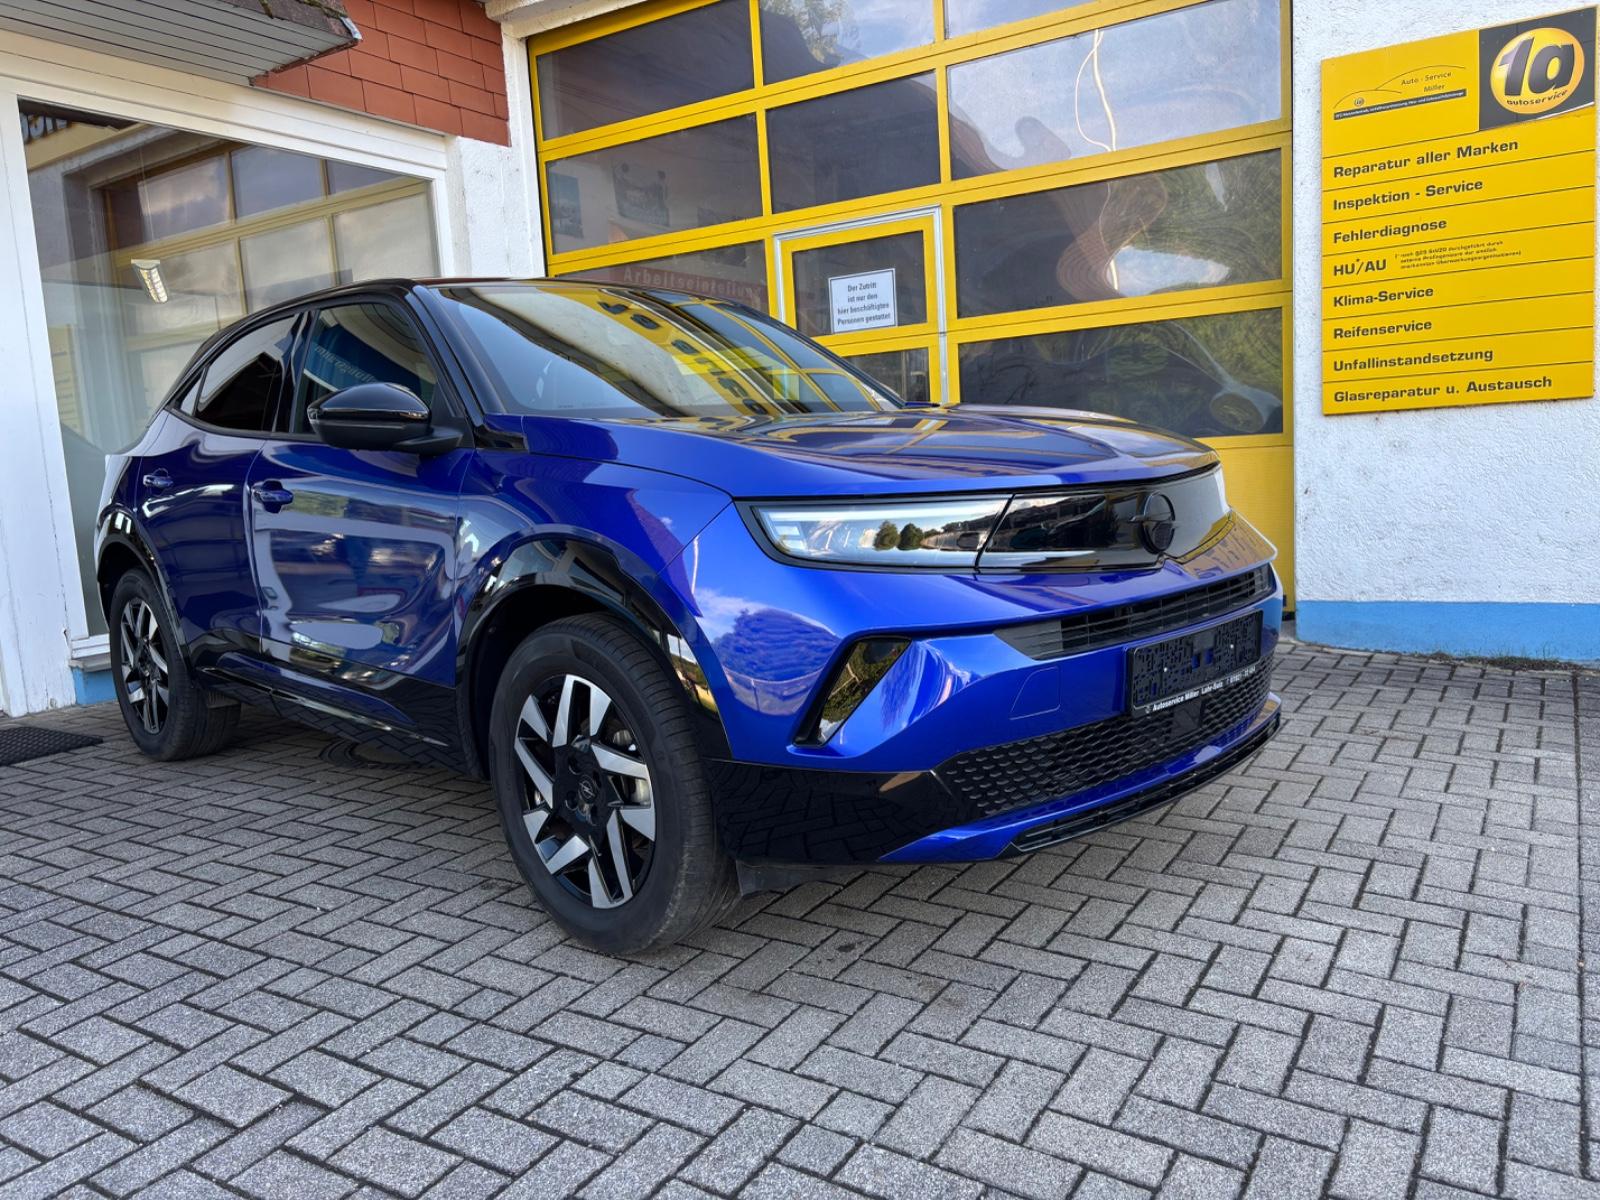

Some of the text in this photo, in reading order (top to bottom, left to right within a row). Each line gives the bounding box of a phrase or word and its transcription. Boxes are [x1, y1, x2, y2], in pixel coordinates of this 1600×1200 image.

[1498, 36, 1575, 96] 1a
[1401, 77, 1419, 86] Auto
[1424, 71, 1452, 82] Service
[1423, 83, 1446, 93] Miller
[1506, 89, 1568, 106] autoservice
[1333, 140, 1519, 178] Reparatur aller Marken
[1333, 190, 1410, 211] Inspektion
[1425, 180, 1483, 198] Service
[1333, 219, 1448, 244] Fehlerdiagnose
[847, 282, 877, 292] Der Zutritt
[847, 295, 856, 303] ist
[1333, 287, 1434, 307] Klima-Service
[837, 302, 890, 315] hier beschäftigten
[837, 312, 891, 326] Personen gestattet
[1333, 321, 1432, 339] Reifenservice
[1333, 350, 1494, 372] Unfallinstandsetzung
[1333, 376, 1553, 403] Glasreparatur u. Austausch
[1152, 694, 1184, 712] Autoservice
